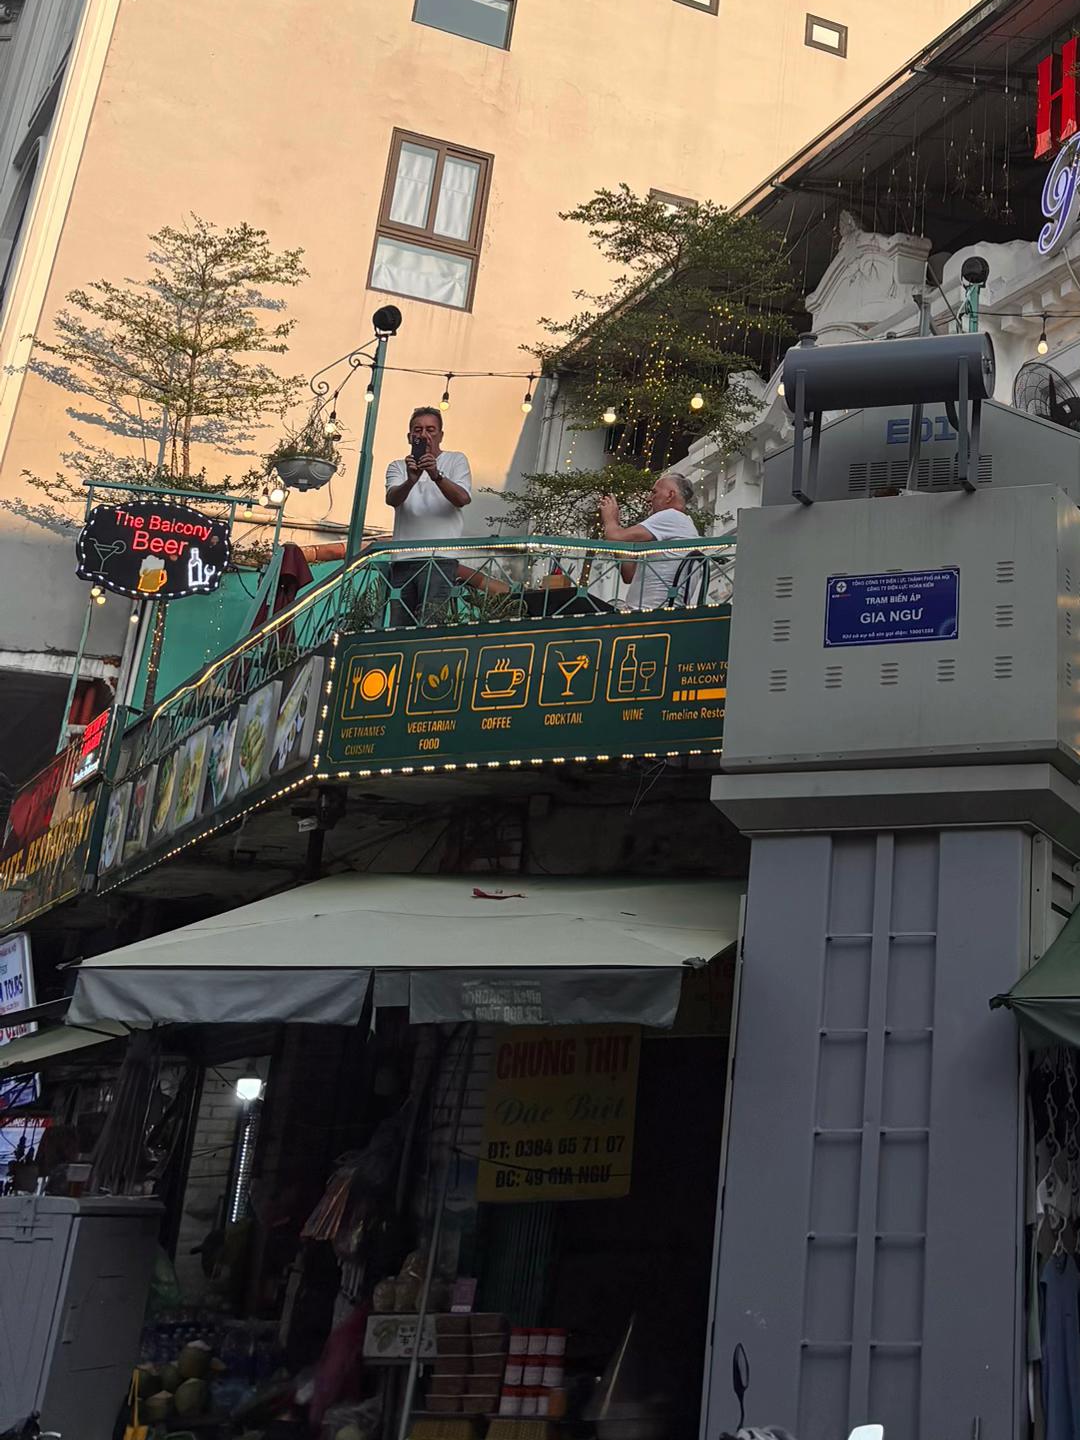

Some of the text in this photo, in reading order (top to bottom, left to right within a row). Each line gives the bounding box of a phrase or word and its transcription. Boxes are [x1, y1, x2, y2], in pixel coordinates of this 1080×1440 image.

[115, 510, 213, 541] The Balcony
[132, 531, 189, 556] Beer
[860, 607, 924, 624] GIA NGƯ
[678, 663, 695, 673] THE
[697, 662, 718, 672] WAY
[681, 674, 726, 686] BALCONY
[544, 712, 584, 726] COCKTAIL
[622, 708, 645, 721] WINE
[661, 707, 726, 721] Timeline Resta
[407, 720, 457, 734] VEGETARIAN
[481, 716, 512, 730] COFFEE
[341, 725, 386, 739] VIETNAMES
[344, 744, 375, 756] CUISINE
[419, 738, 440, 750] FOOD
[582, 1136, 599, 1153] 71
[606, 1136, 626, 1152] 07
